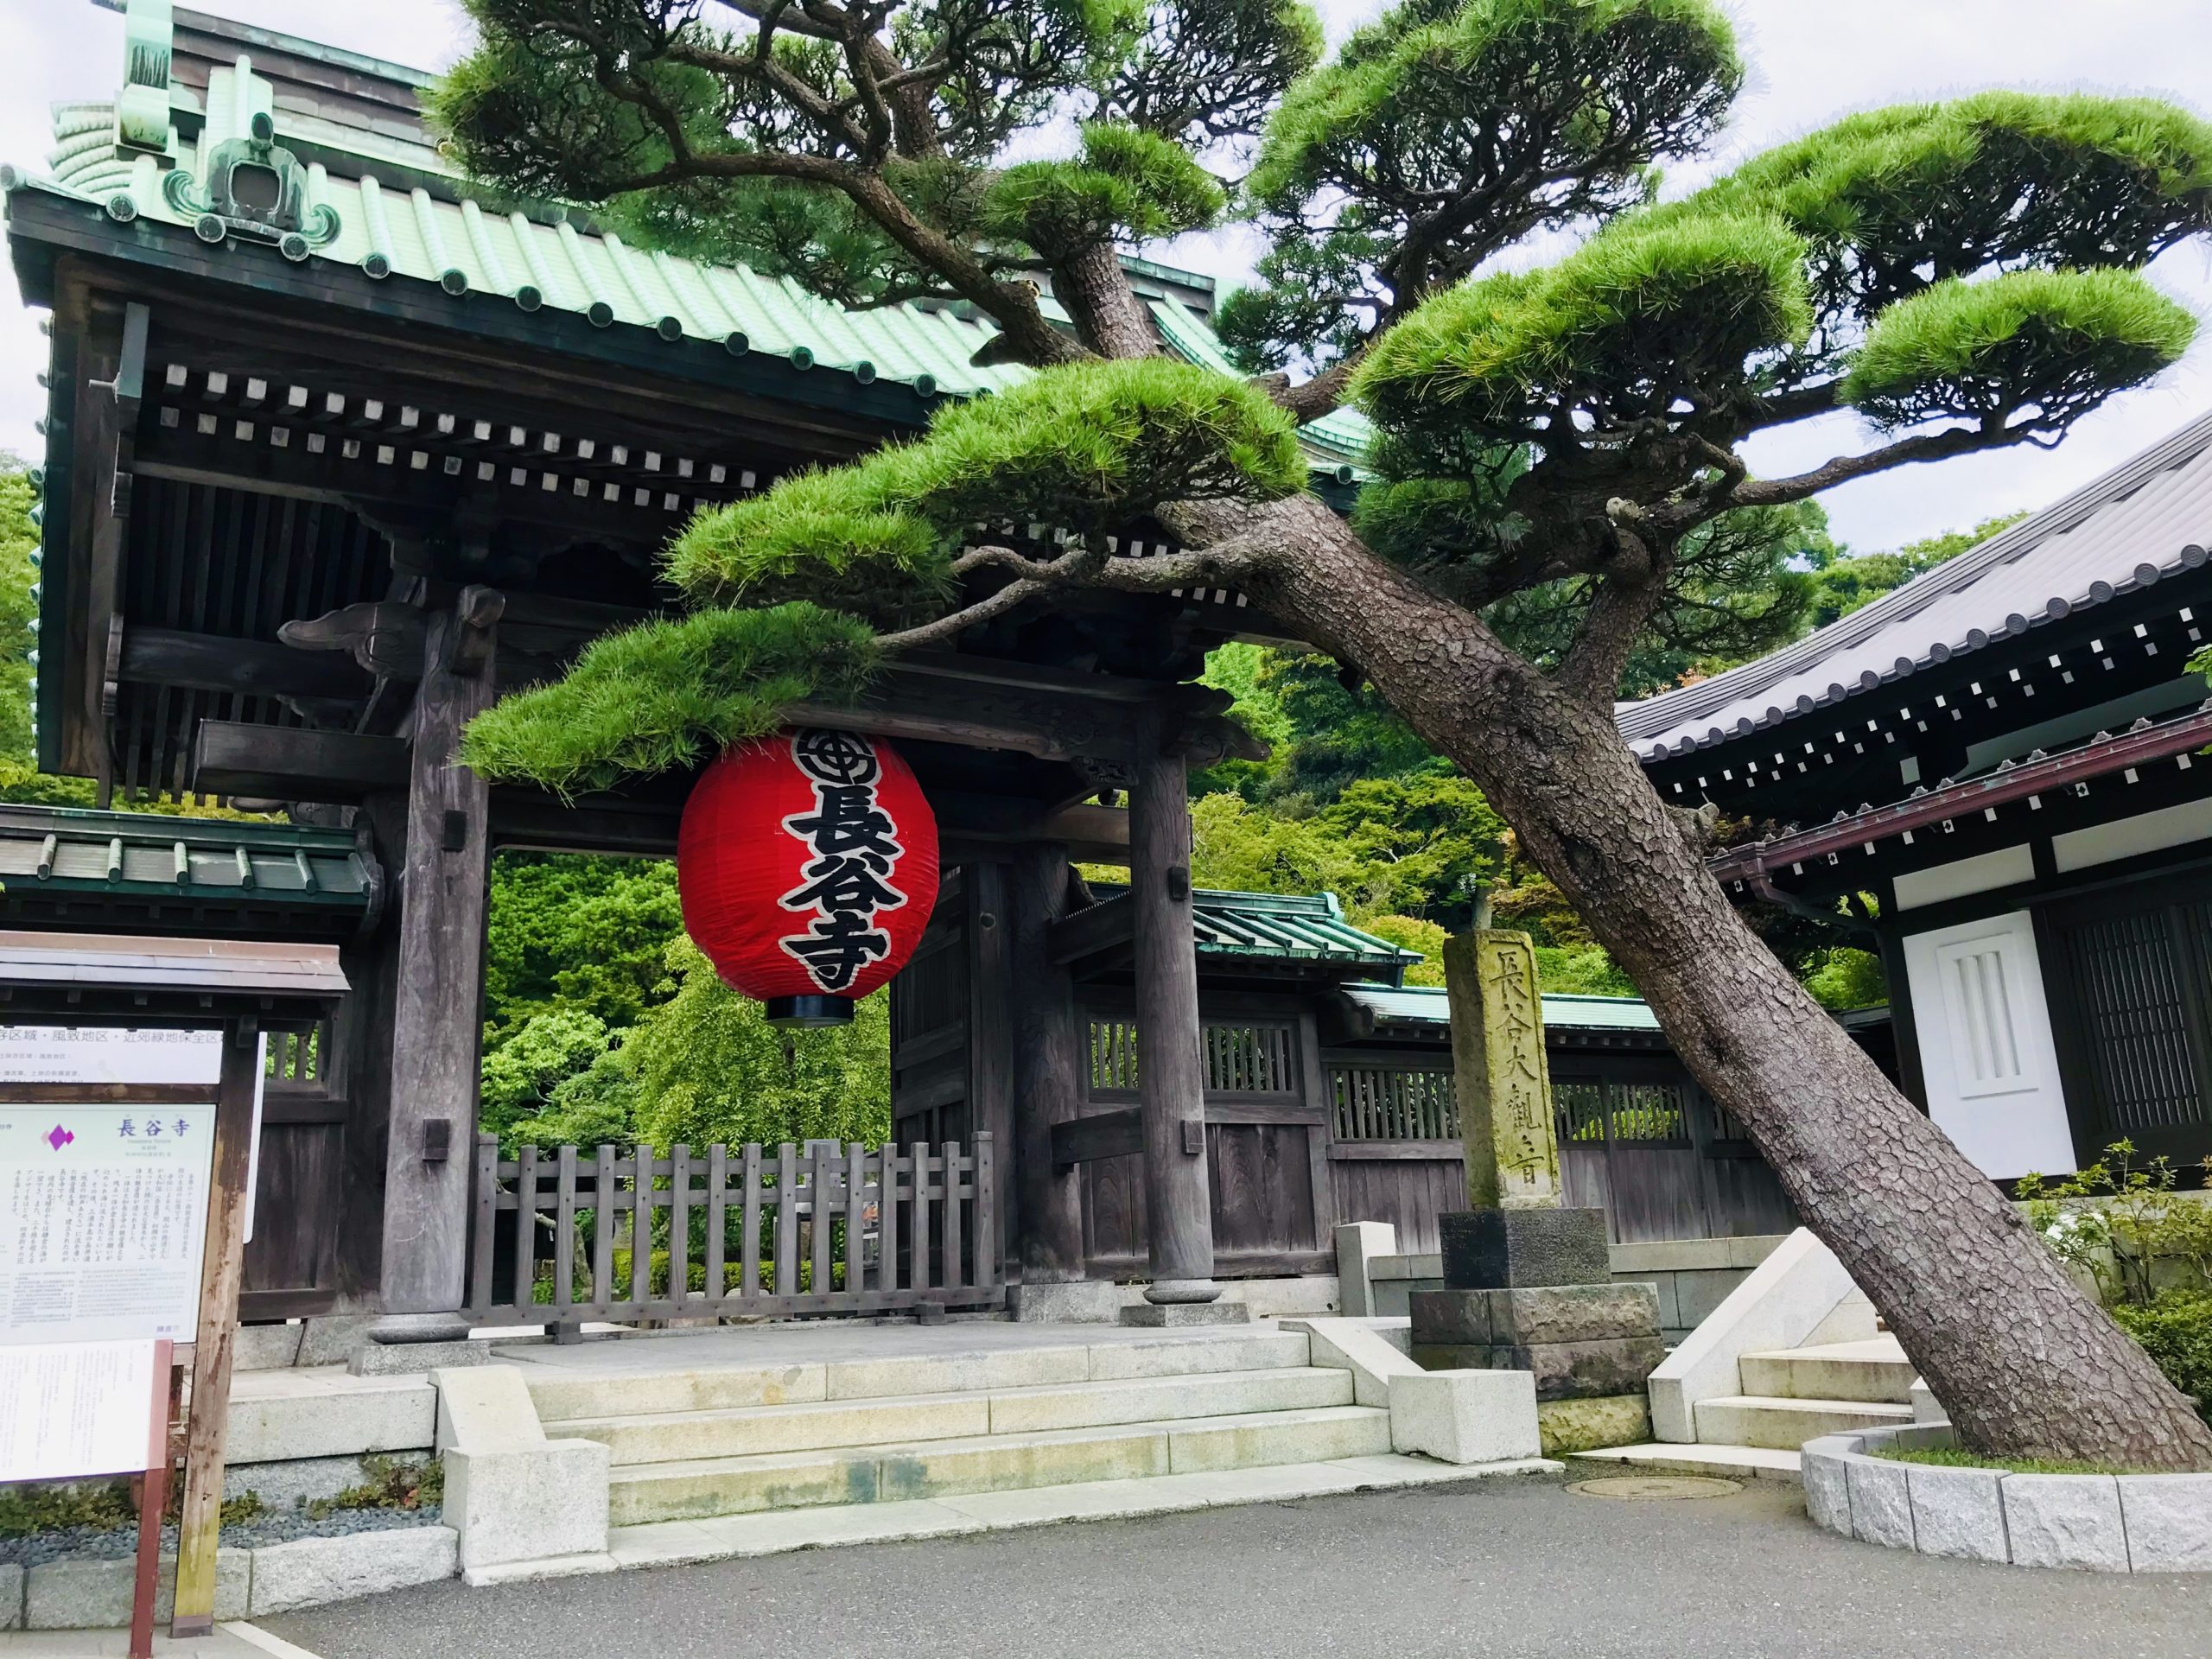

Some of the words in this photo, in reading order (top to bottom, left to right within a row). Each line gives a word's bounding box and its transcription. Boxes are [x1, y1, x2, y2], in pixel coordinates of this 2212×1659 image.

[778, 780, 907, 994] 長谷寺
[0, 1029, 223, 1044] 区域・風致地区・近郊緑地保全区
[118, 1118, 190, 1137] 長谷寺
